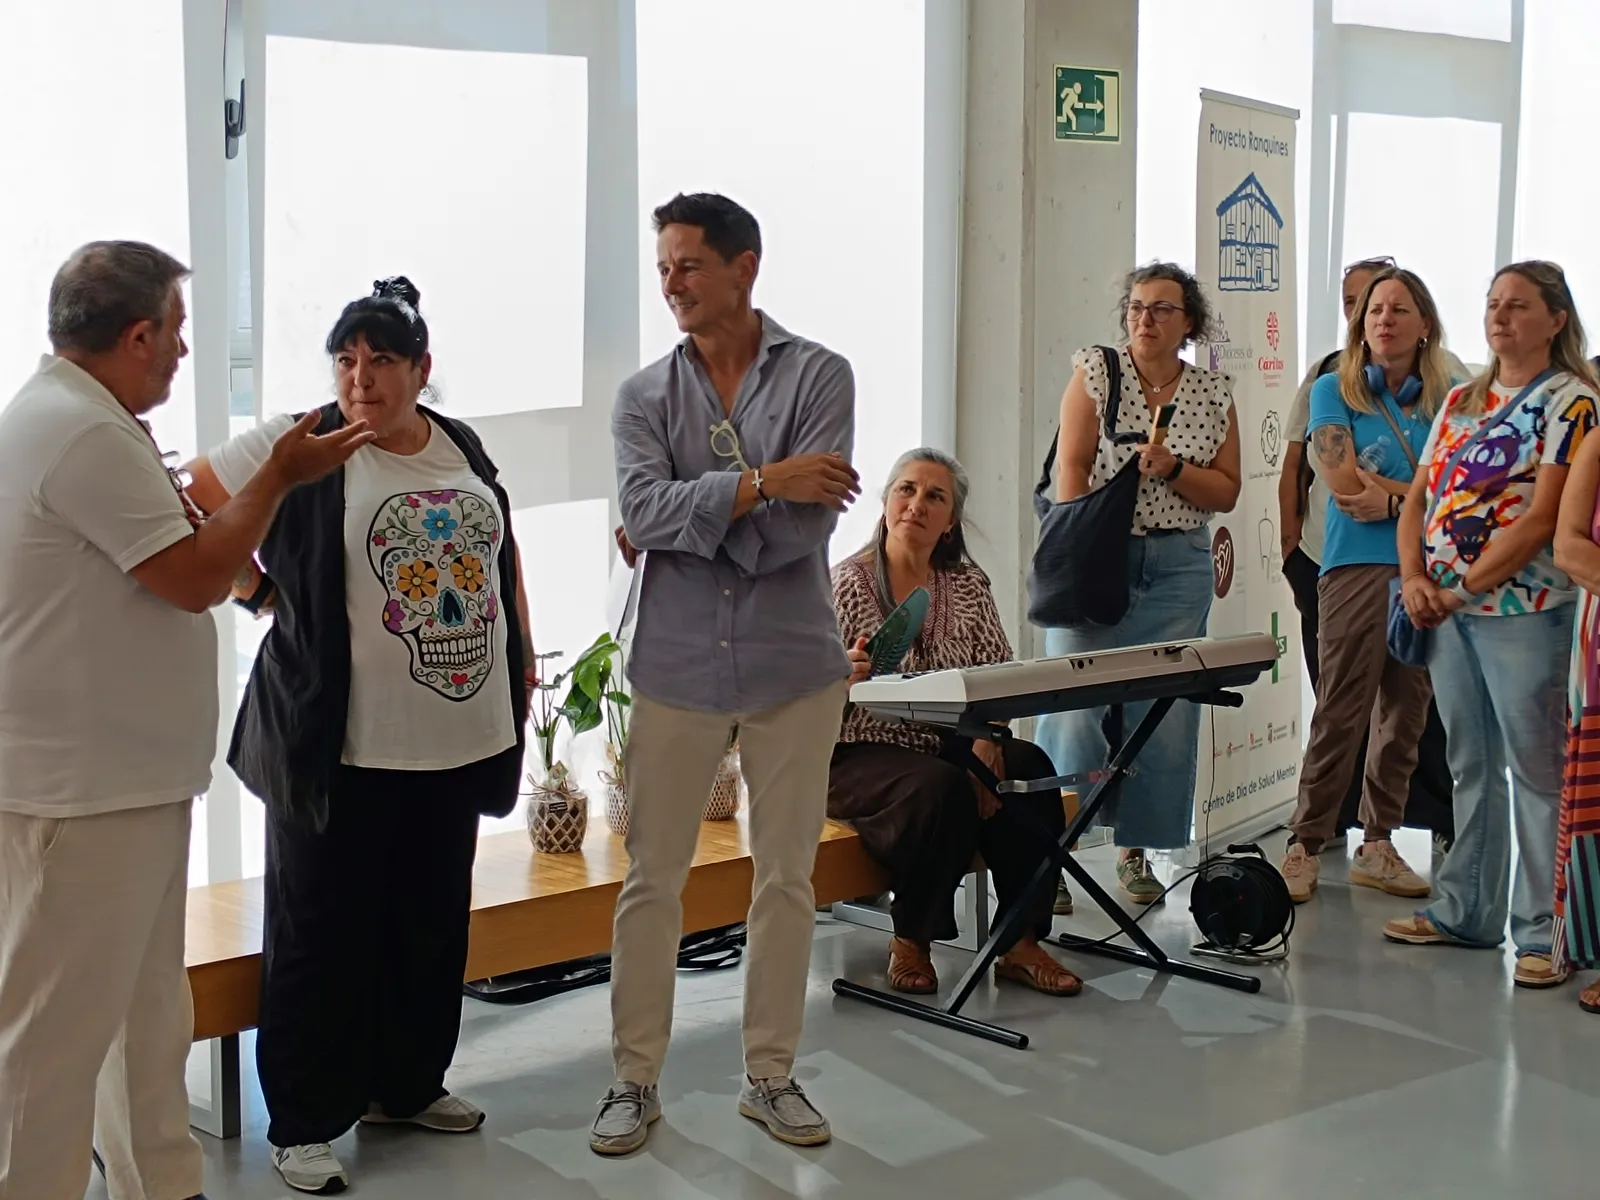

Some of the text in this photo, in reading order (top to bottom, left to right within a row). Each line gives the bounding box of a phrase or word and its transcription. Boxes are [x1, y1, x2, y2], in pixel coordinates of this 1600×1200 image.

[1210, 123, 1288, 158] Proyecto Ranquines
[1202, 795, 1224, 814] Centro
[1226, 789, 1235, 804] de
[1249, 780, 1257, 794] de
[1258, 771, 1275, 790] Salud
[1276, 762, 1296, 781] Mental
